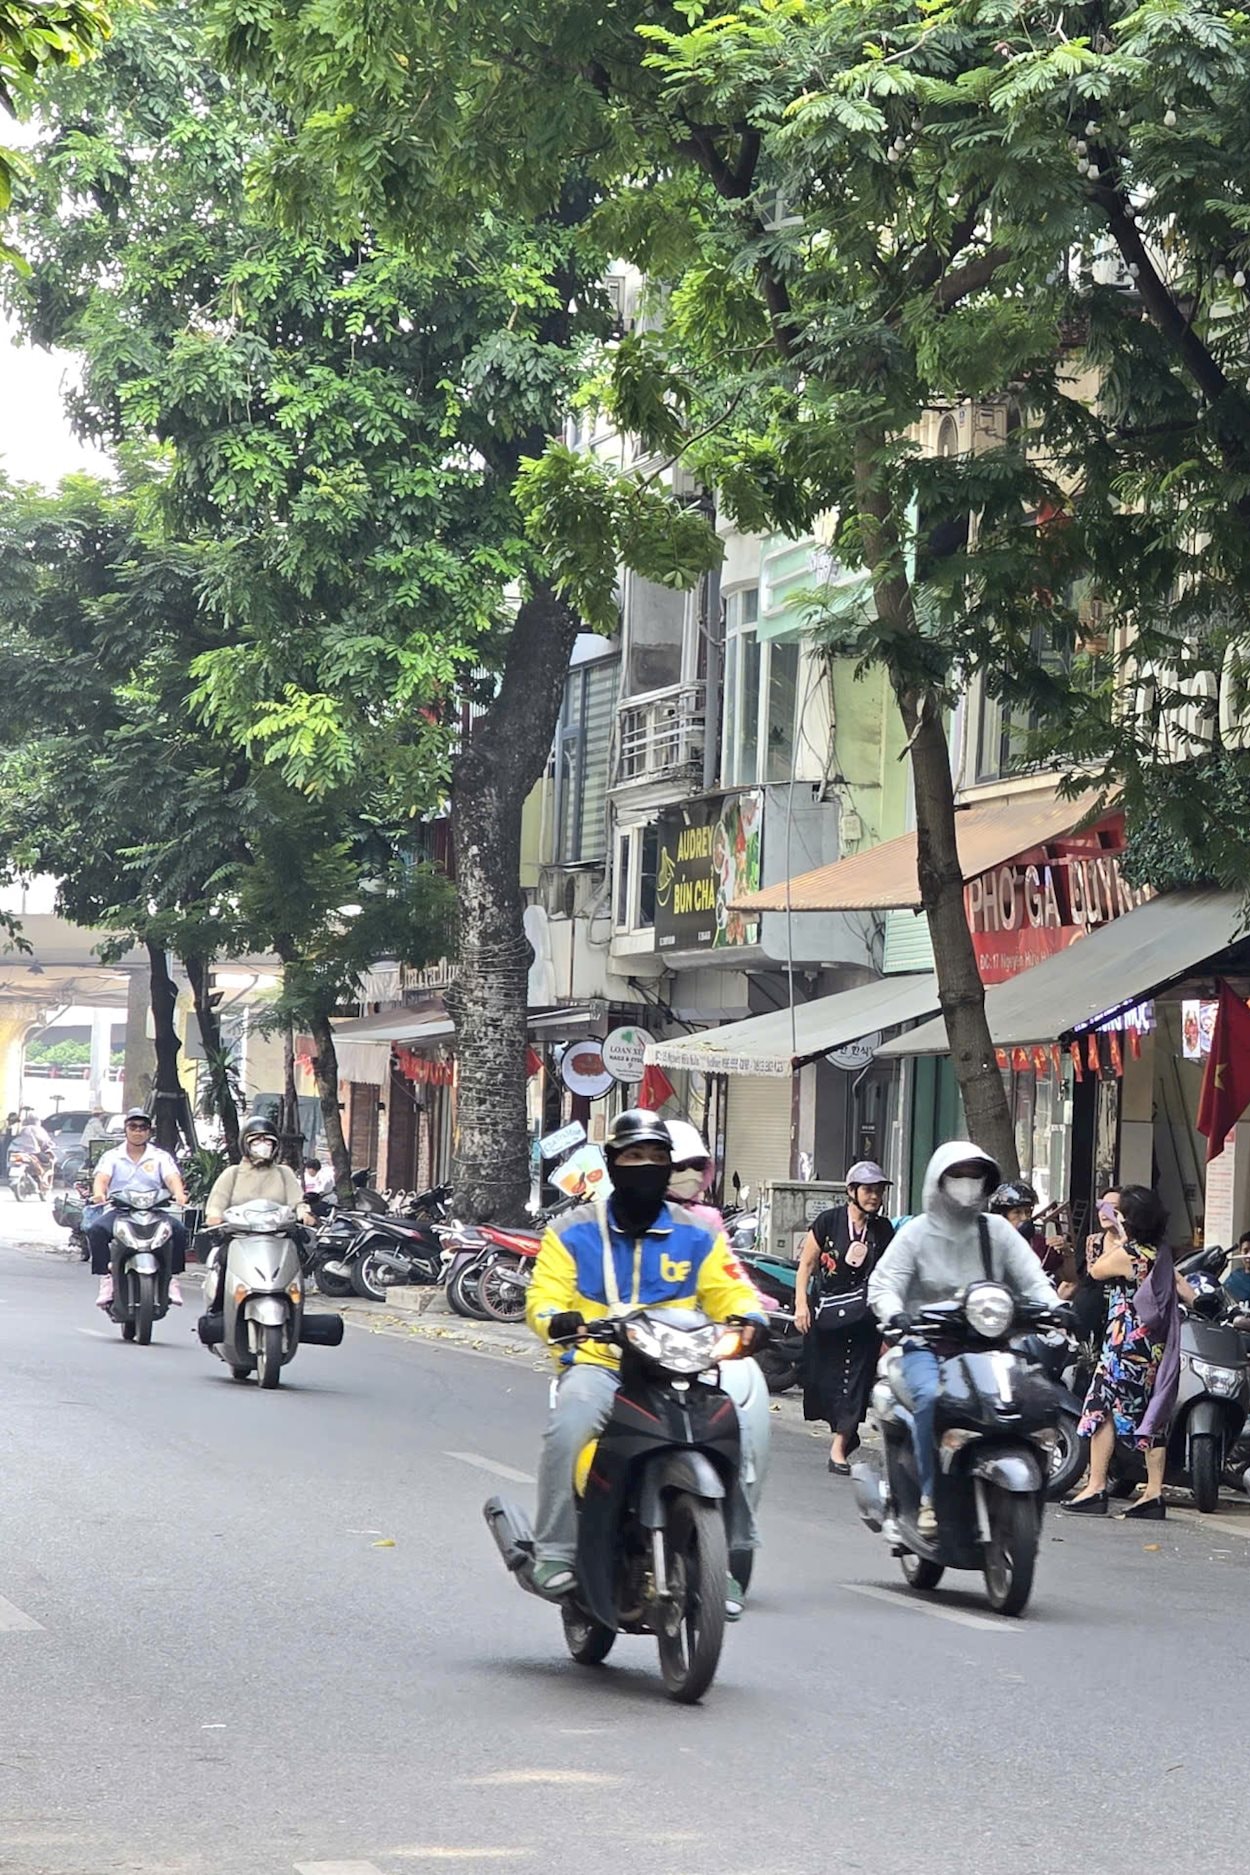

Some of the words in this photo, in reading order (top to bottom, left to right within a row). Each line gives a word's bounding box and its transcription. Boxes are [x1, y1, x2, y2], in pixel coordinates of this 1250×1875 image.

[677, 825, 715, 862] AUDREY
[674, 874, 693, 914] BÚN
[694, 864, 716, 911] CHẢ
[610, 1046, 632, 1054] LOAN
